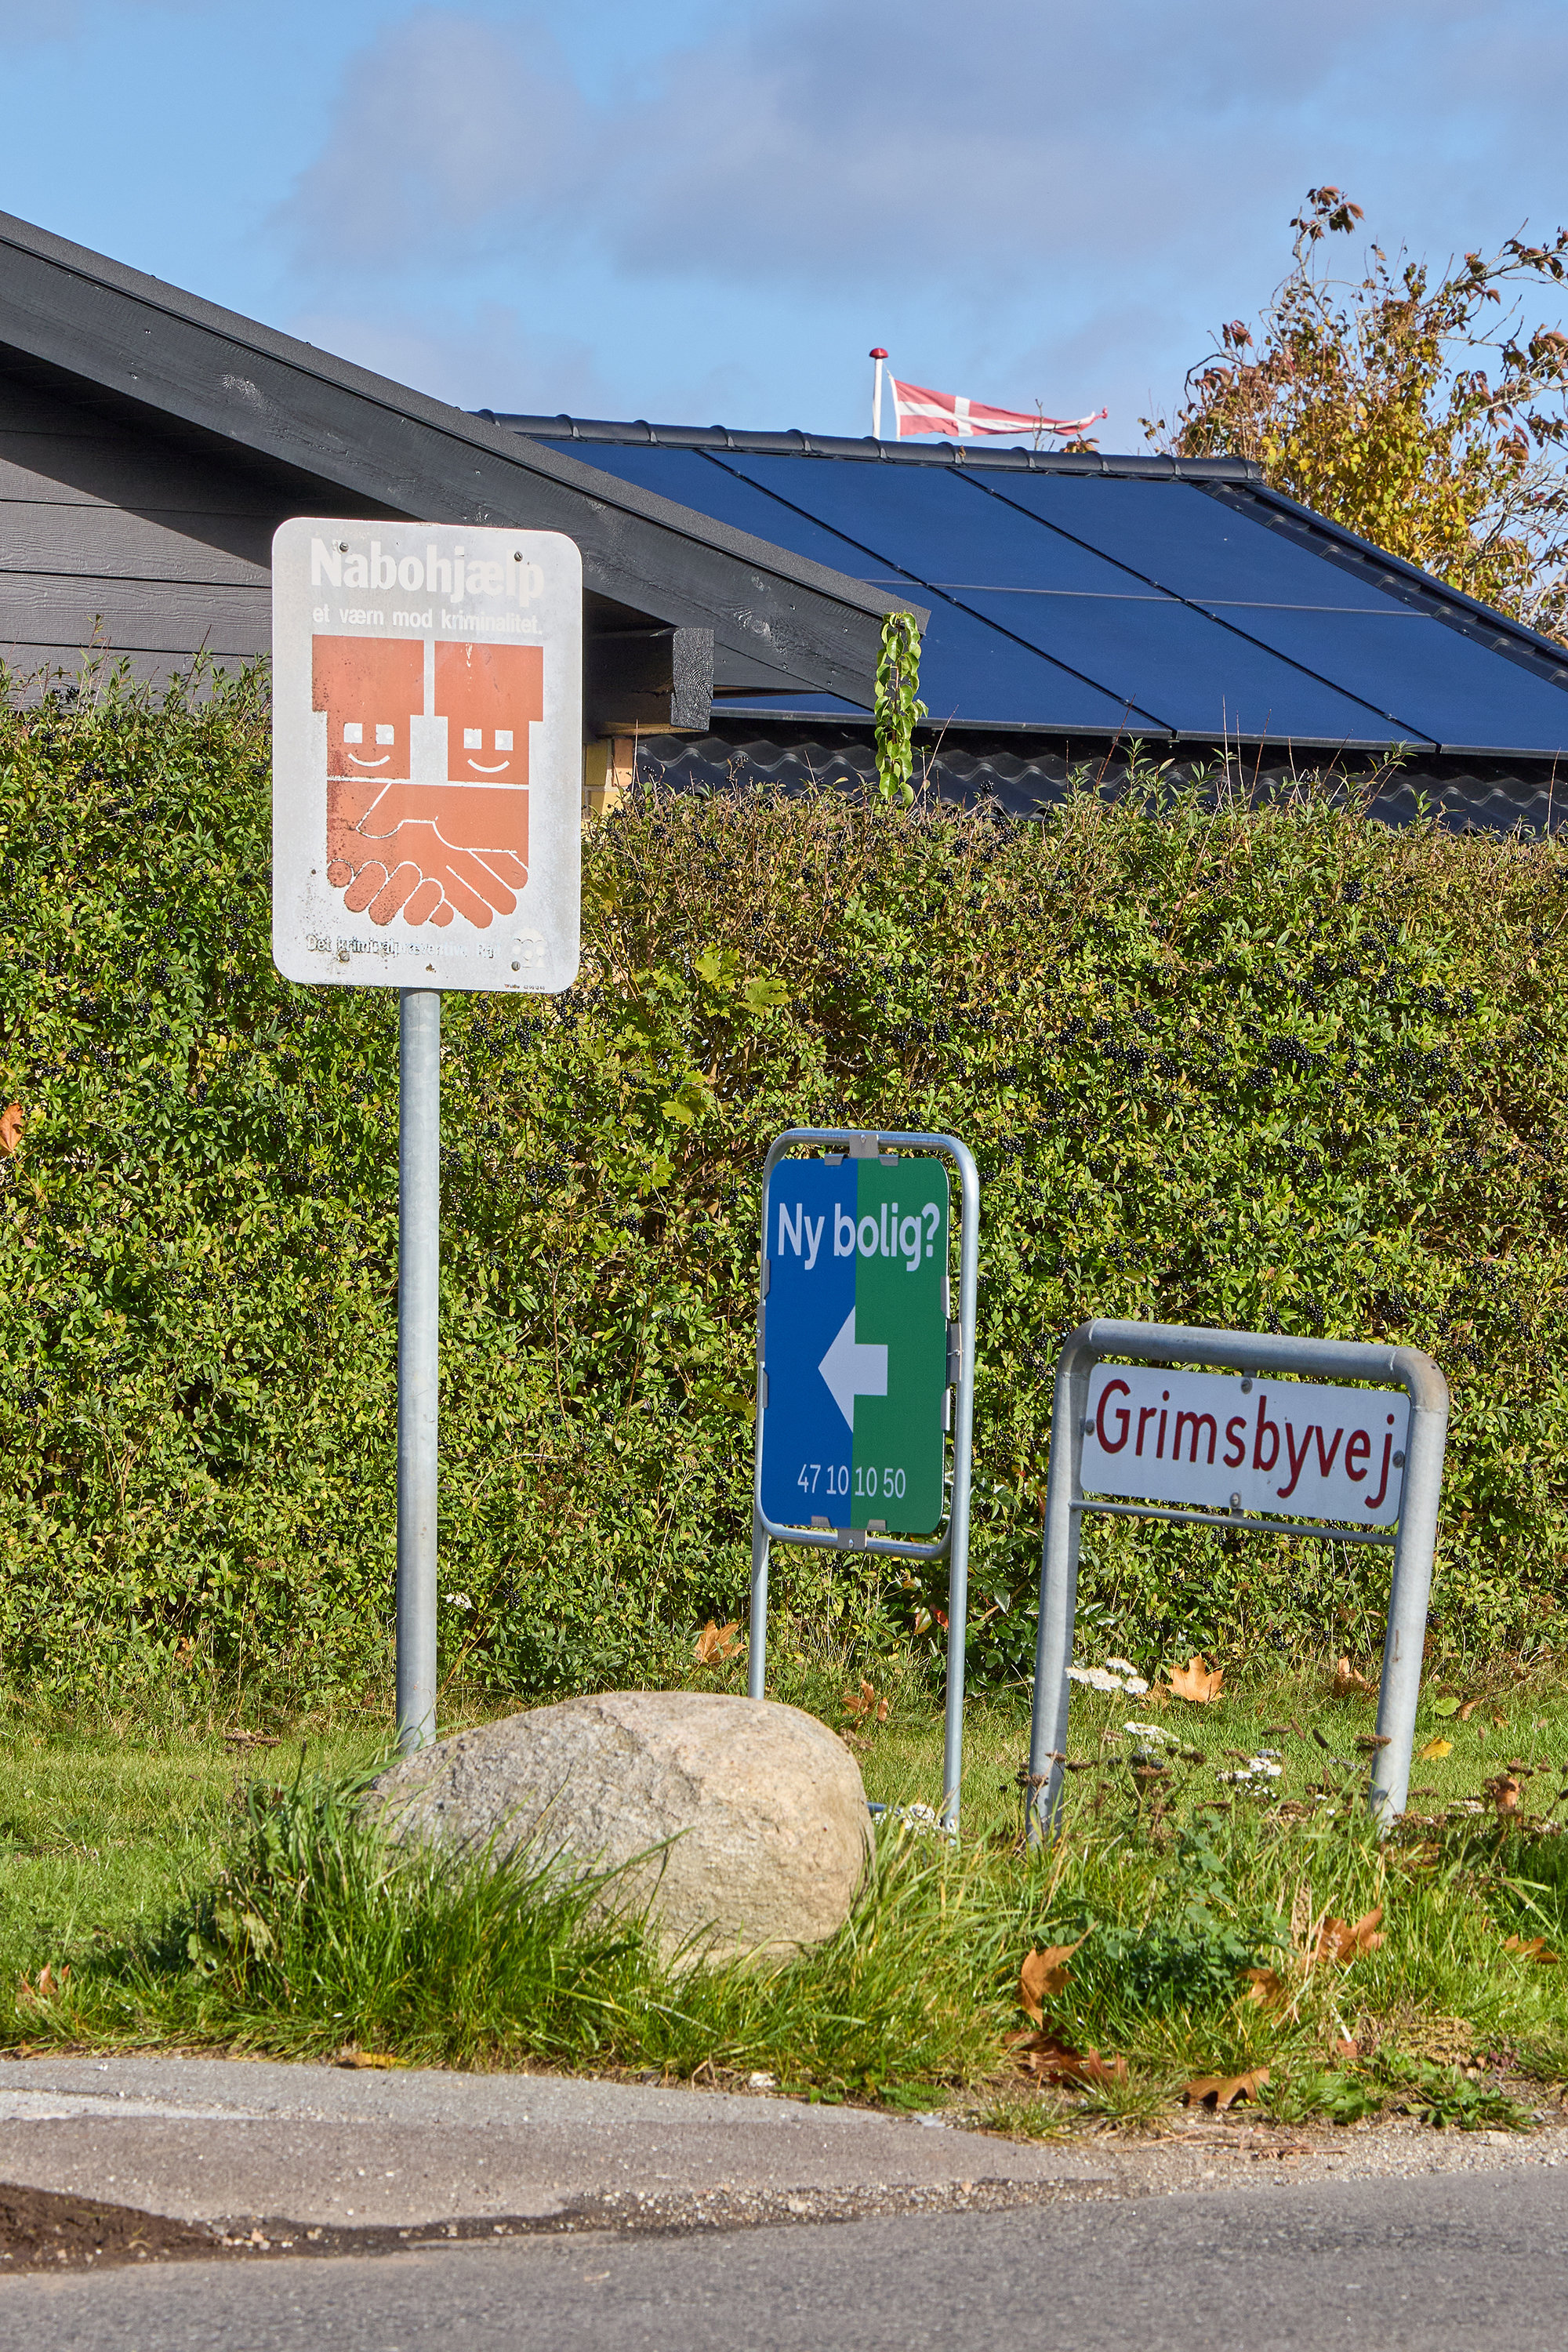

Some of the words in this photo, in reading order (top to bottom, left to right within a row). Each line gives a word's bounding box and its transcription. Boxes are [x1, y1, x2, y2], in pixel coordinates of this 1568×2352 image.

[310, 538, 545, 608] Nabohjælp
[313, 604, 330, 623] et
[339, 608, 384, 626] værn
[392, 608, 433, 629] mod
[441, 608, 543, 636] kriminalitet.
[306, 932, 332, 953] Det
[778, 1203, 826, 1271] Ny
[833, 1202, 941, 1272] bolig?
[1097, 1378, 1395, 1509] Grimsbyvej
[797, 1464, 822, 1494] 47
[826, 1465, 849, 1496] 10
[855, 1466, 878, 1497] 10
[883, 1468, 906, 1499] 50
